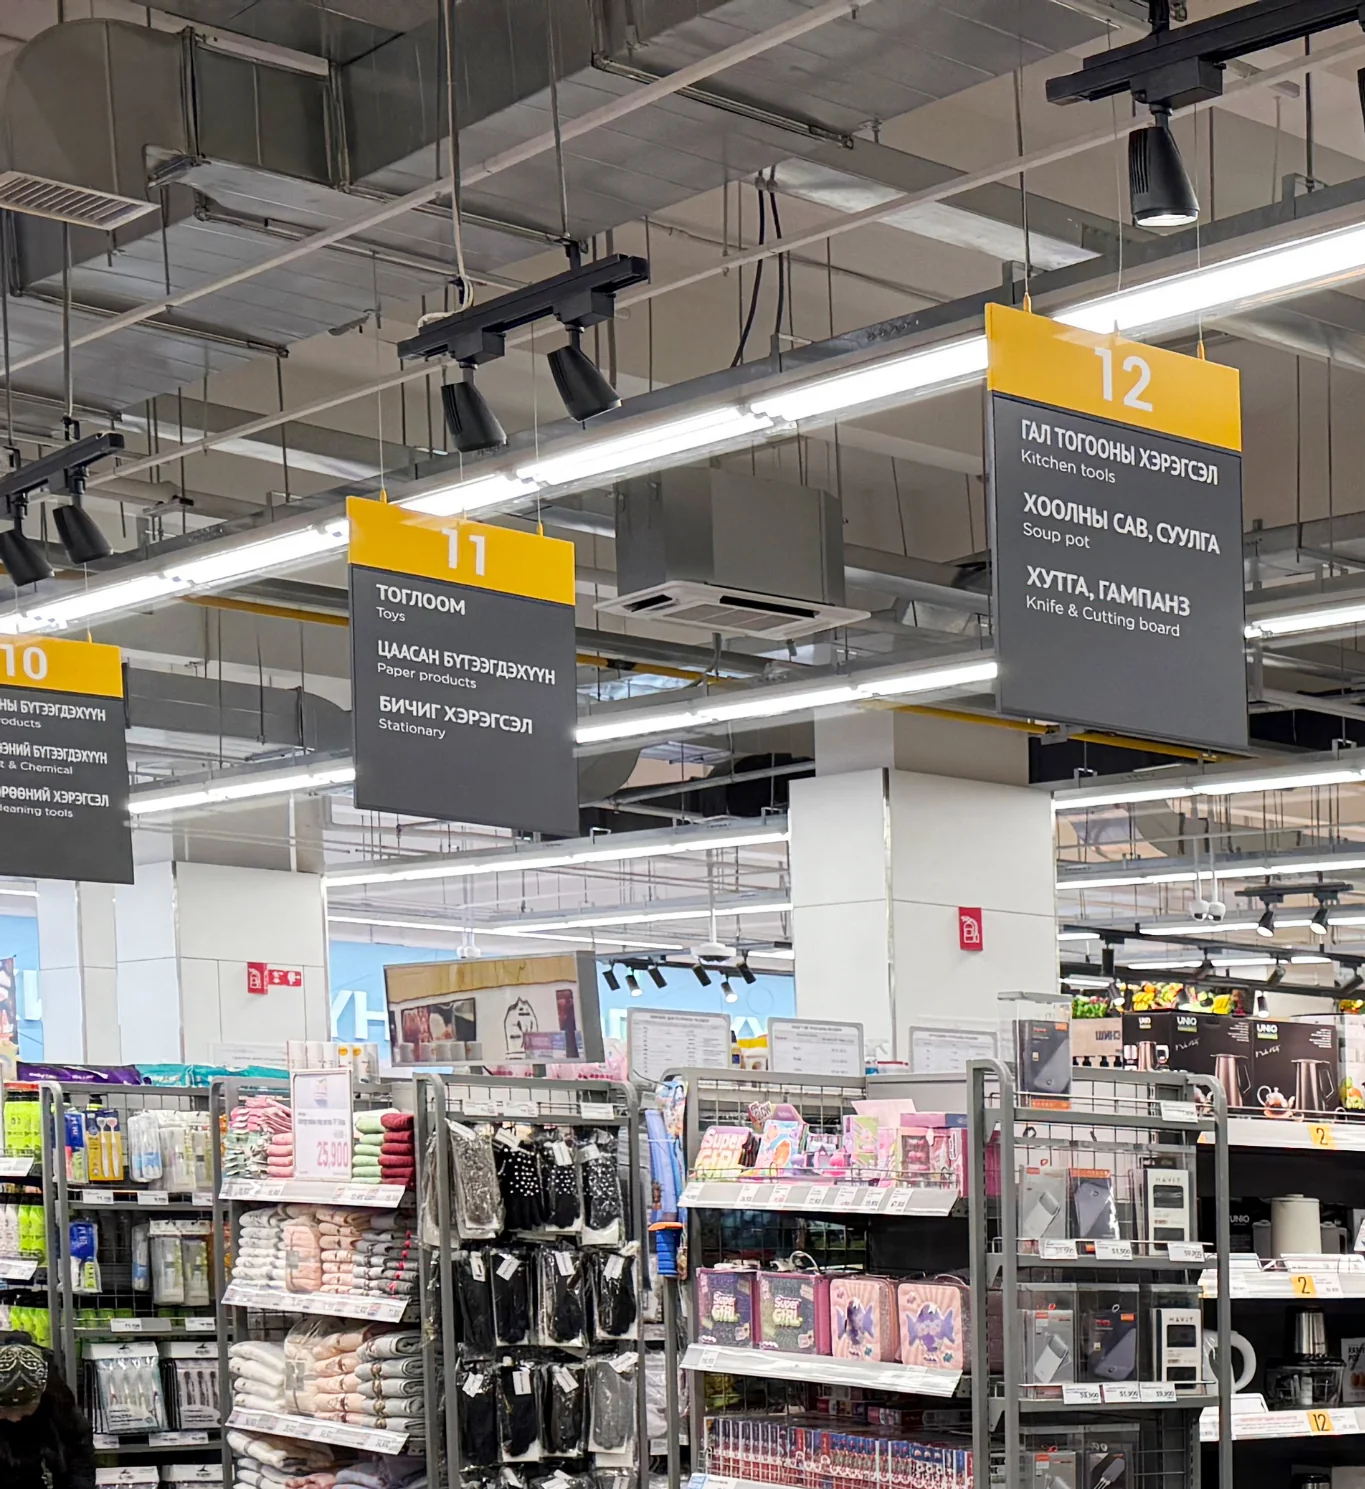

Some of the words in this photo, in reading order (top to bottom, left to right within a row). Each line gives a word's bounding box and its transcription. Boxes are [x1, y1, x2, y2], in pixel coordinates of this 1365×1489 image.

[1094, 347, 1153, 412] 12
[1021, 419, 1051, 446] ГАЛ
[1054, 426, 1135, 465] ТОГООНЫ
[1139, 448, 1219, 486] ХЭРЭГСЭЛ
[1021, 449, 1077, 475] Kitchen
[1080, 463, 1116, 484] tools
[1023, 522, 1061, 544] Soup
[1065, 531, 1091, 550] pot
[1024, 492, 1108, 530] ХООЛНЫ
[1113, 513, 1153, 543] САВ,
[1156, 523, 1221, 555] СУУЛГА
[441, 528, 485, 576] 11
[376, 584, 466, 615] ТОГЛООМ
[1026, 565, 1095, 600] ХУТГА,
[1098, 579, 1191, 617] ГАМПАНЗ
[376, 607, 406, 622] Toys
[1026, 595, 1064, 616] Knife
[1068, 604, 1079, 618] &
[1083, 606, 1135, 632] Cutting
[1139, 616, 1180, 637] board
[0, 643, 48, 681] 10
[378, 640, 440, 665] ЦААСАН
[443, 652, 556, 685] БҮТЭЭГДЭХҮҮН
[378, 663, 415, 680] Paper
[419, 671, 477, 689] products
[378, 718, 446, 740] Stationary
[379, 695, 441, 721] БИЧИГ
[444, 705, 533, 734] ХЭРЭГСЭЛ
[8, 760, 17, 770] &
[20, 761, 73, 775] Chemical
[45, 808, 73, 818] tools
[53, 791, 110, 807] ХЭРЭГСЭЛ
[1316, 1129, 1328, 1145] 2
[317, 1142, 349, 1169] 25,900
[1298, 1277, 1310, 1294] 2
[1313, 1413, 1327, 1432] 12
